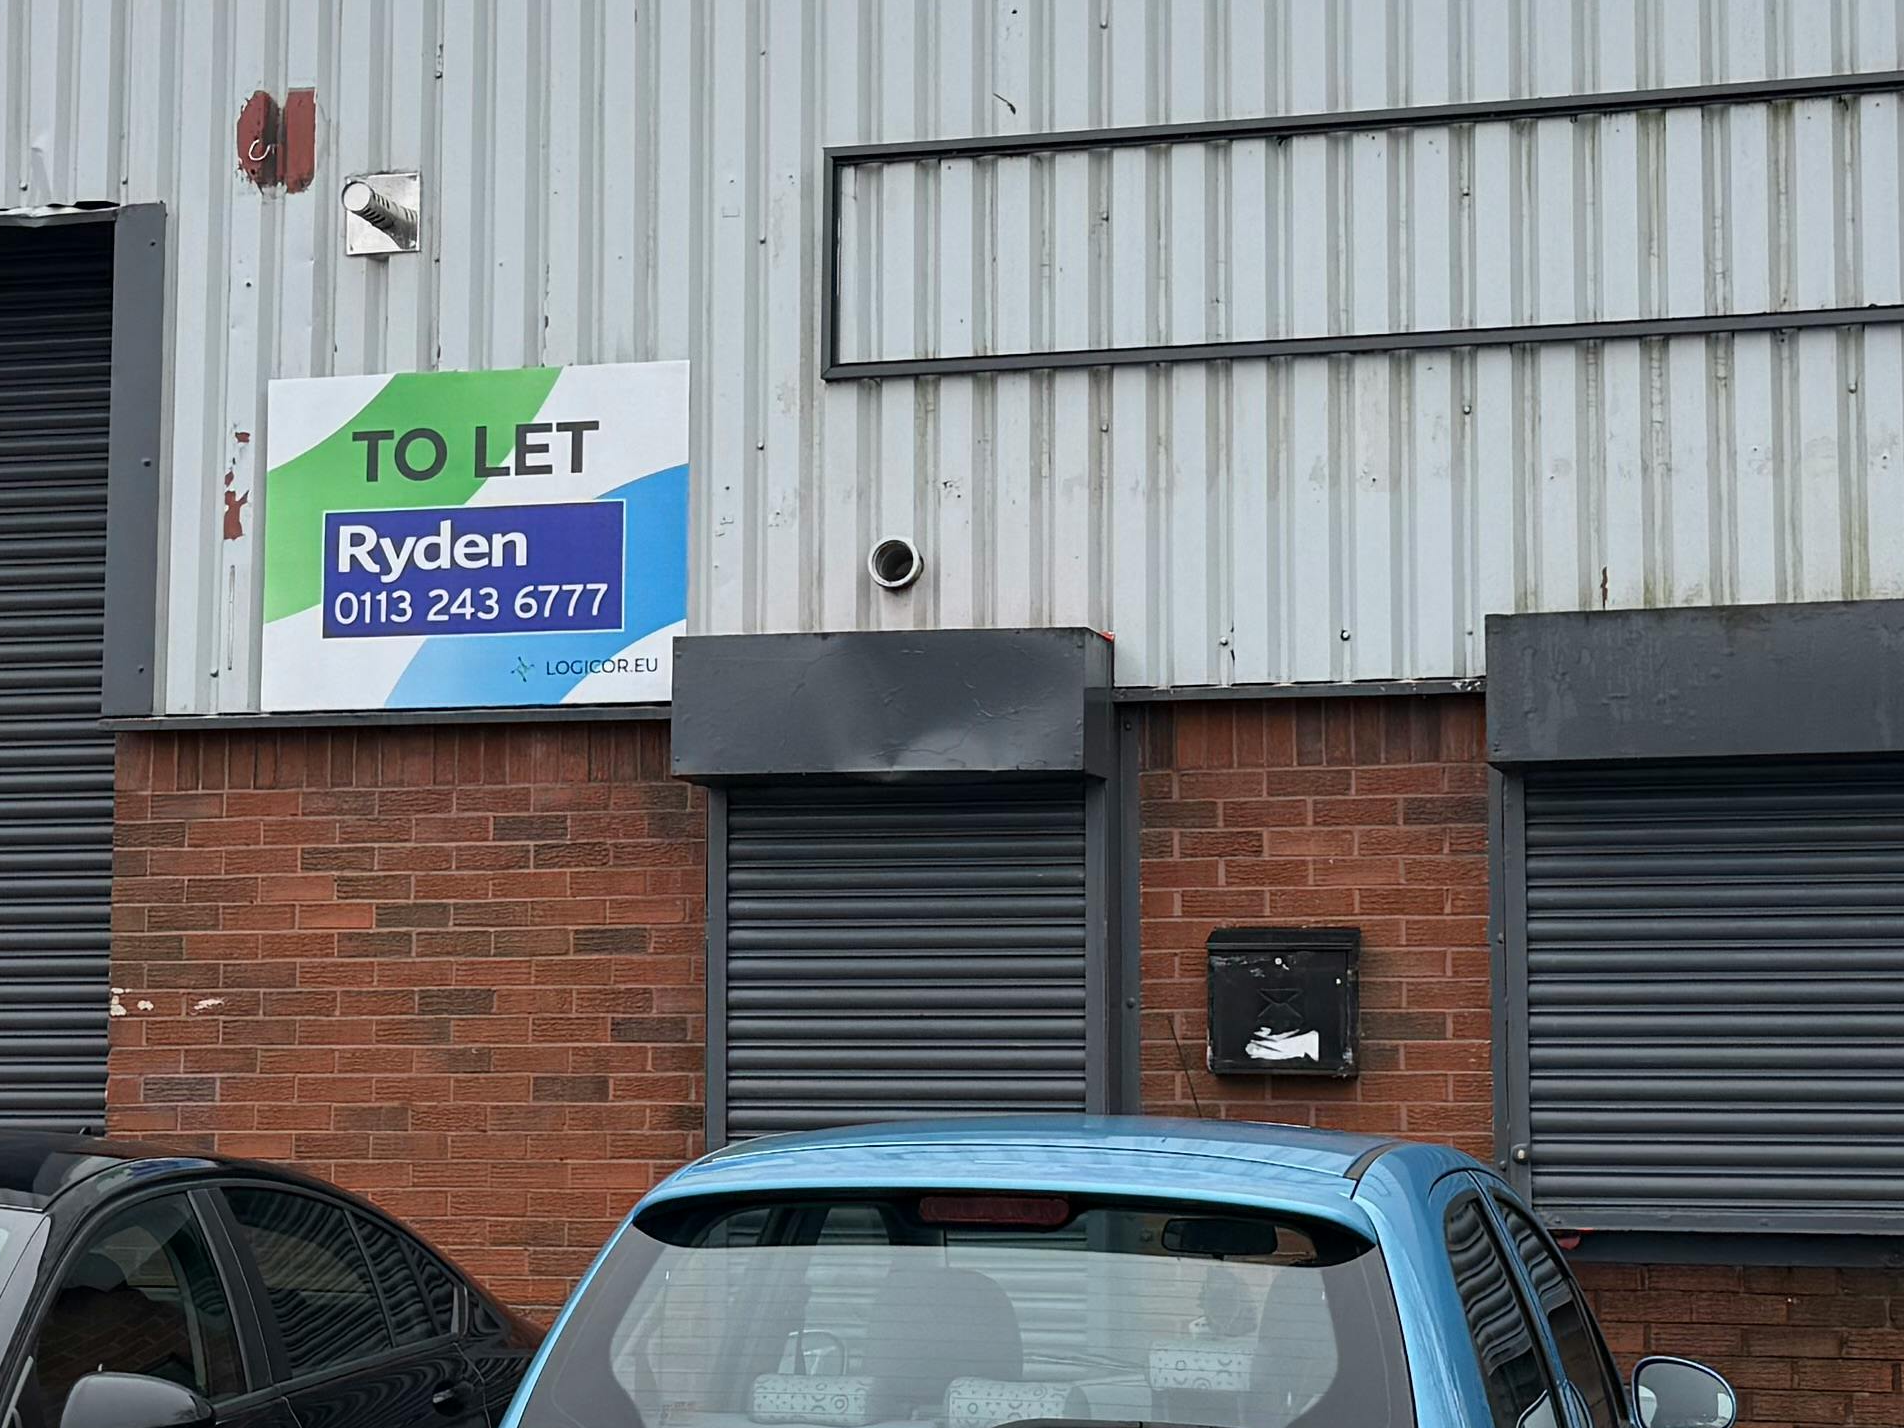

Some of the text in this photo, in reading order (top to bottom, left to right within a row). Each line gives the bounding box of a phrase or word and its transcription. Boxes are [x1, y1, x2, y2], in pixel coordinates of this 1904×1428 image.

[352, 420, 600, 482] TO LET
[338, 520, 527, 583] Ryden
[334, 583, 608, 625] 0113 243 6777
[546, 657, 658, 676] LOGICOR.EU
